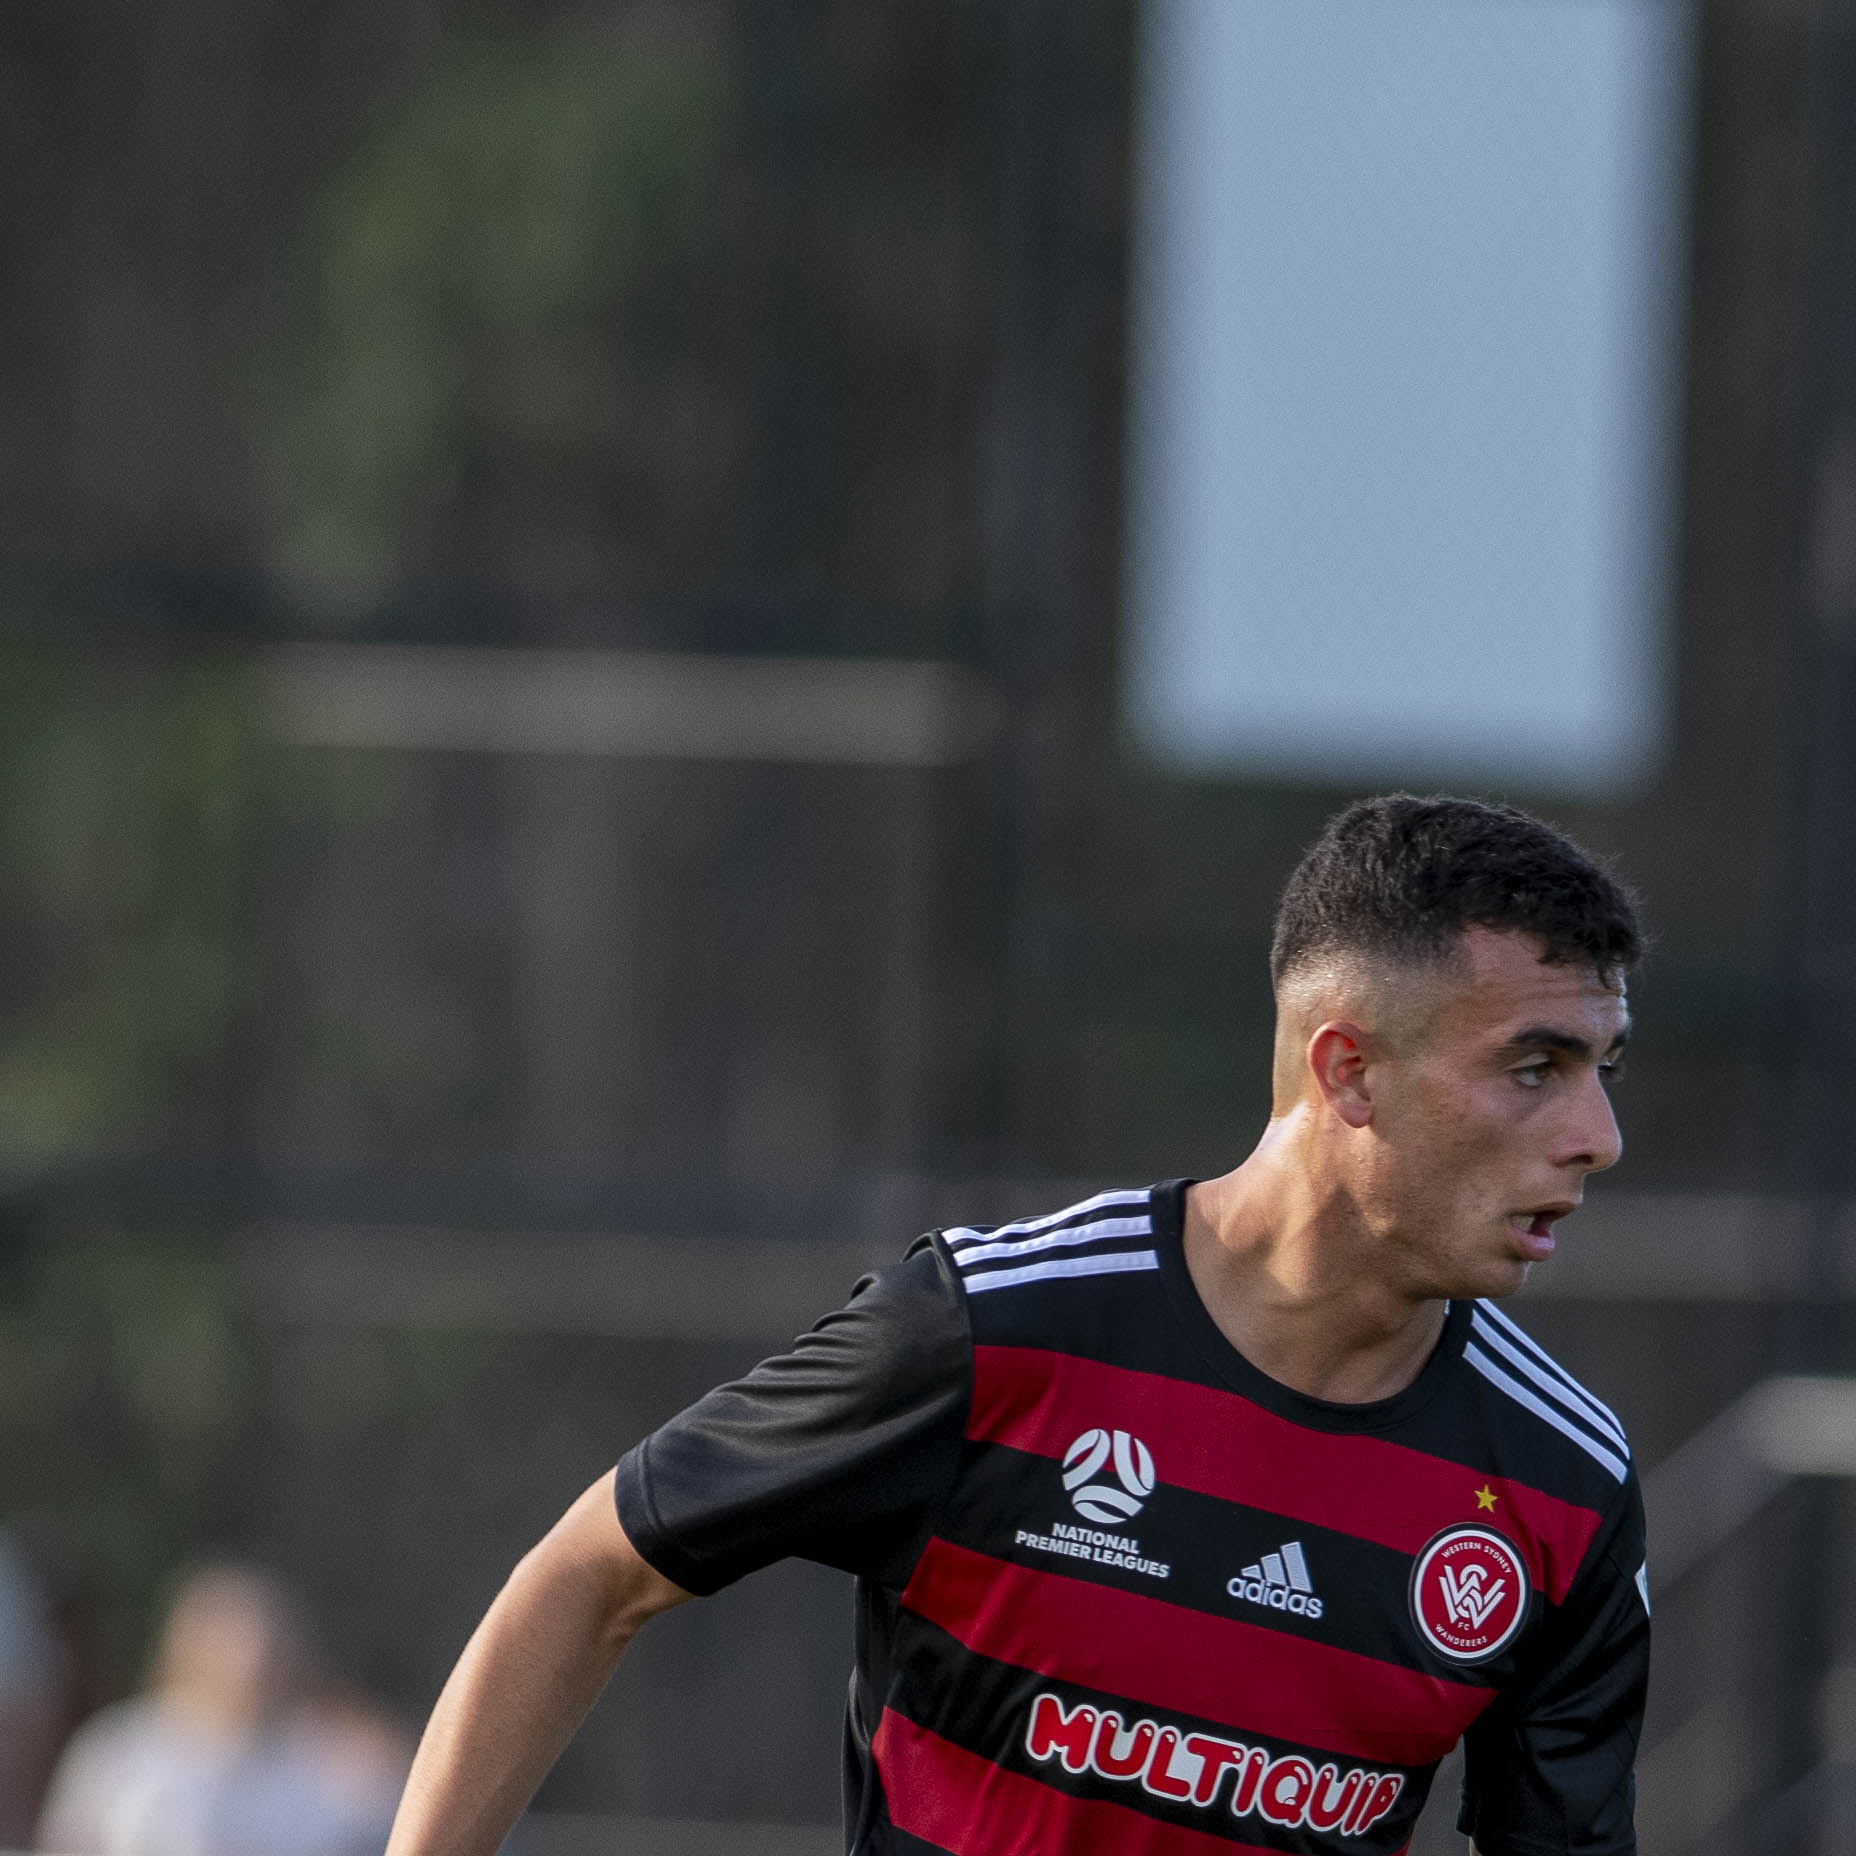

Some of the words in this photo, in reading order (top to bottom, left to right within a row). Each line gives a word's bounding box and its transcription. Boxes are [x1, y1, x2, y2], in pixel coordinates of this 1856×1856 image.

[1014, 1530, 1091, 1560] PREMIER
[1092, 1547, 1171, 1578] LEAGUES
[1051, 1522, 1141, 1554] NATIONAL
[1441, 1541, 1482, 1559] WESTERN
[1483, 1545, 1512, 1574] SYDNEY
[1226, 1577, 1323, 1619] adidas
[1435, 1623, 1488, 1647] WANDERERS
[1457, 1621, 1471, 1631] FC
[1025, 1693, 1405, 1837] MULTIQUIP
